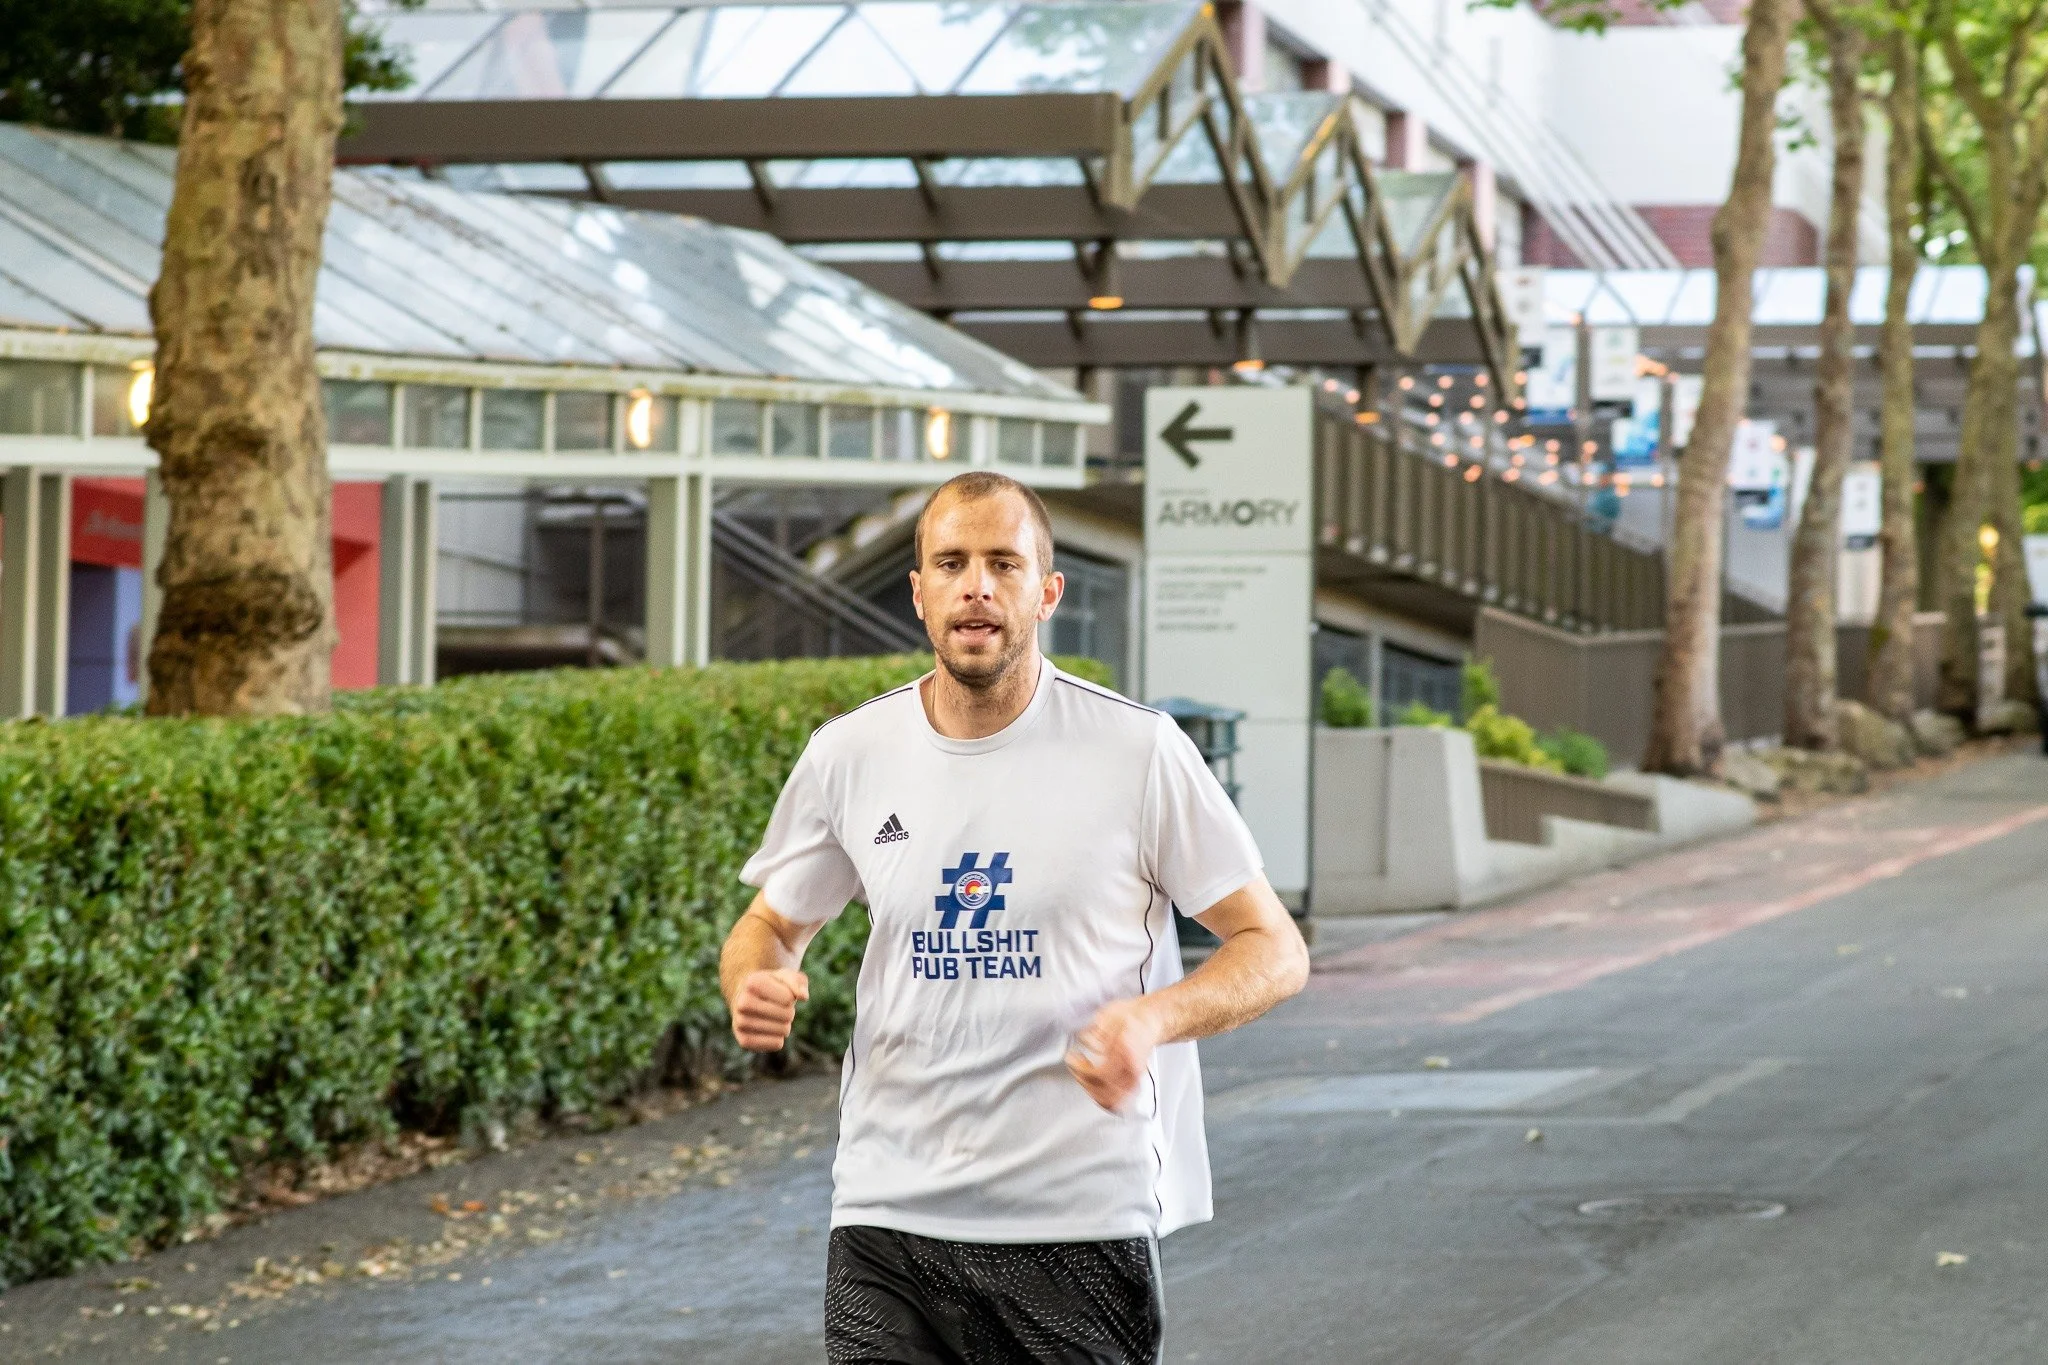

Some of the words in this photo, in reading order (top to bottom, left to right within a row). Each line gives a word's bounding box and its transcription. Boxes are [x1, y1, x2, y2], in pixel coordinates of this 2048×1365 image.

[1157, 499, 1299, 526] ARMORY
[874, 830, 909, 845] adidas
[911, 930, 1039, 954] BULLSHIT
[911, 956, 959, 980] PUB
[965, 956, 1042, 979] TEAM
